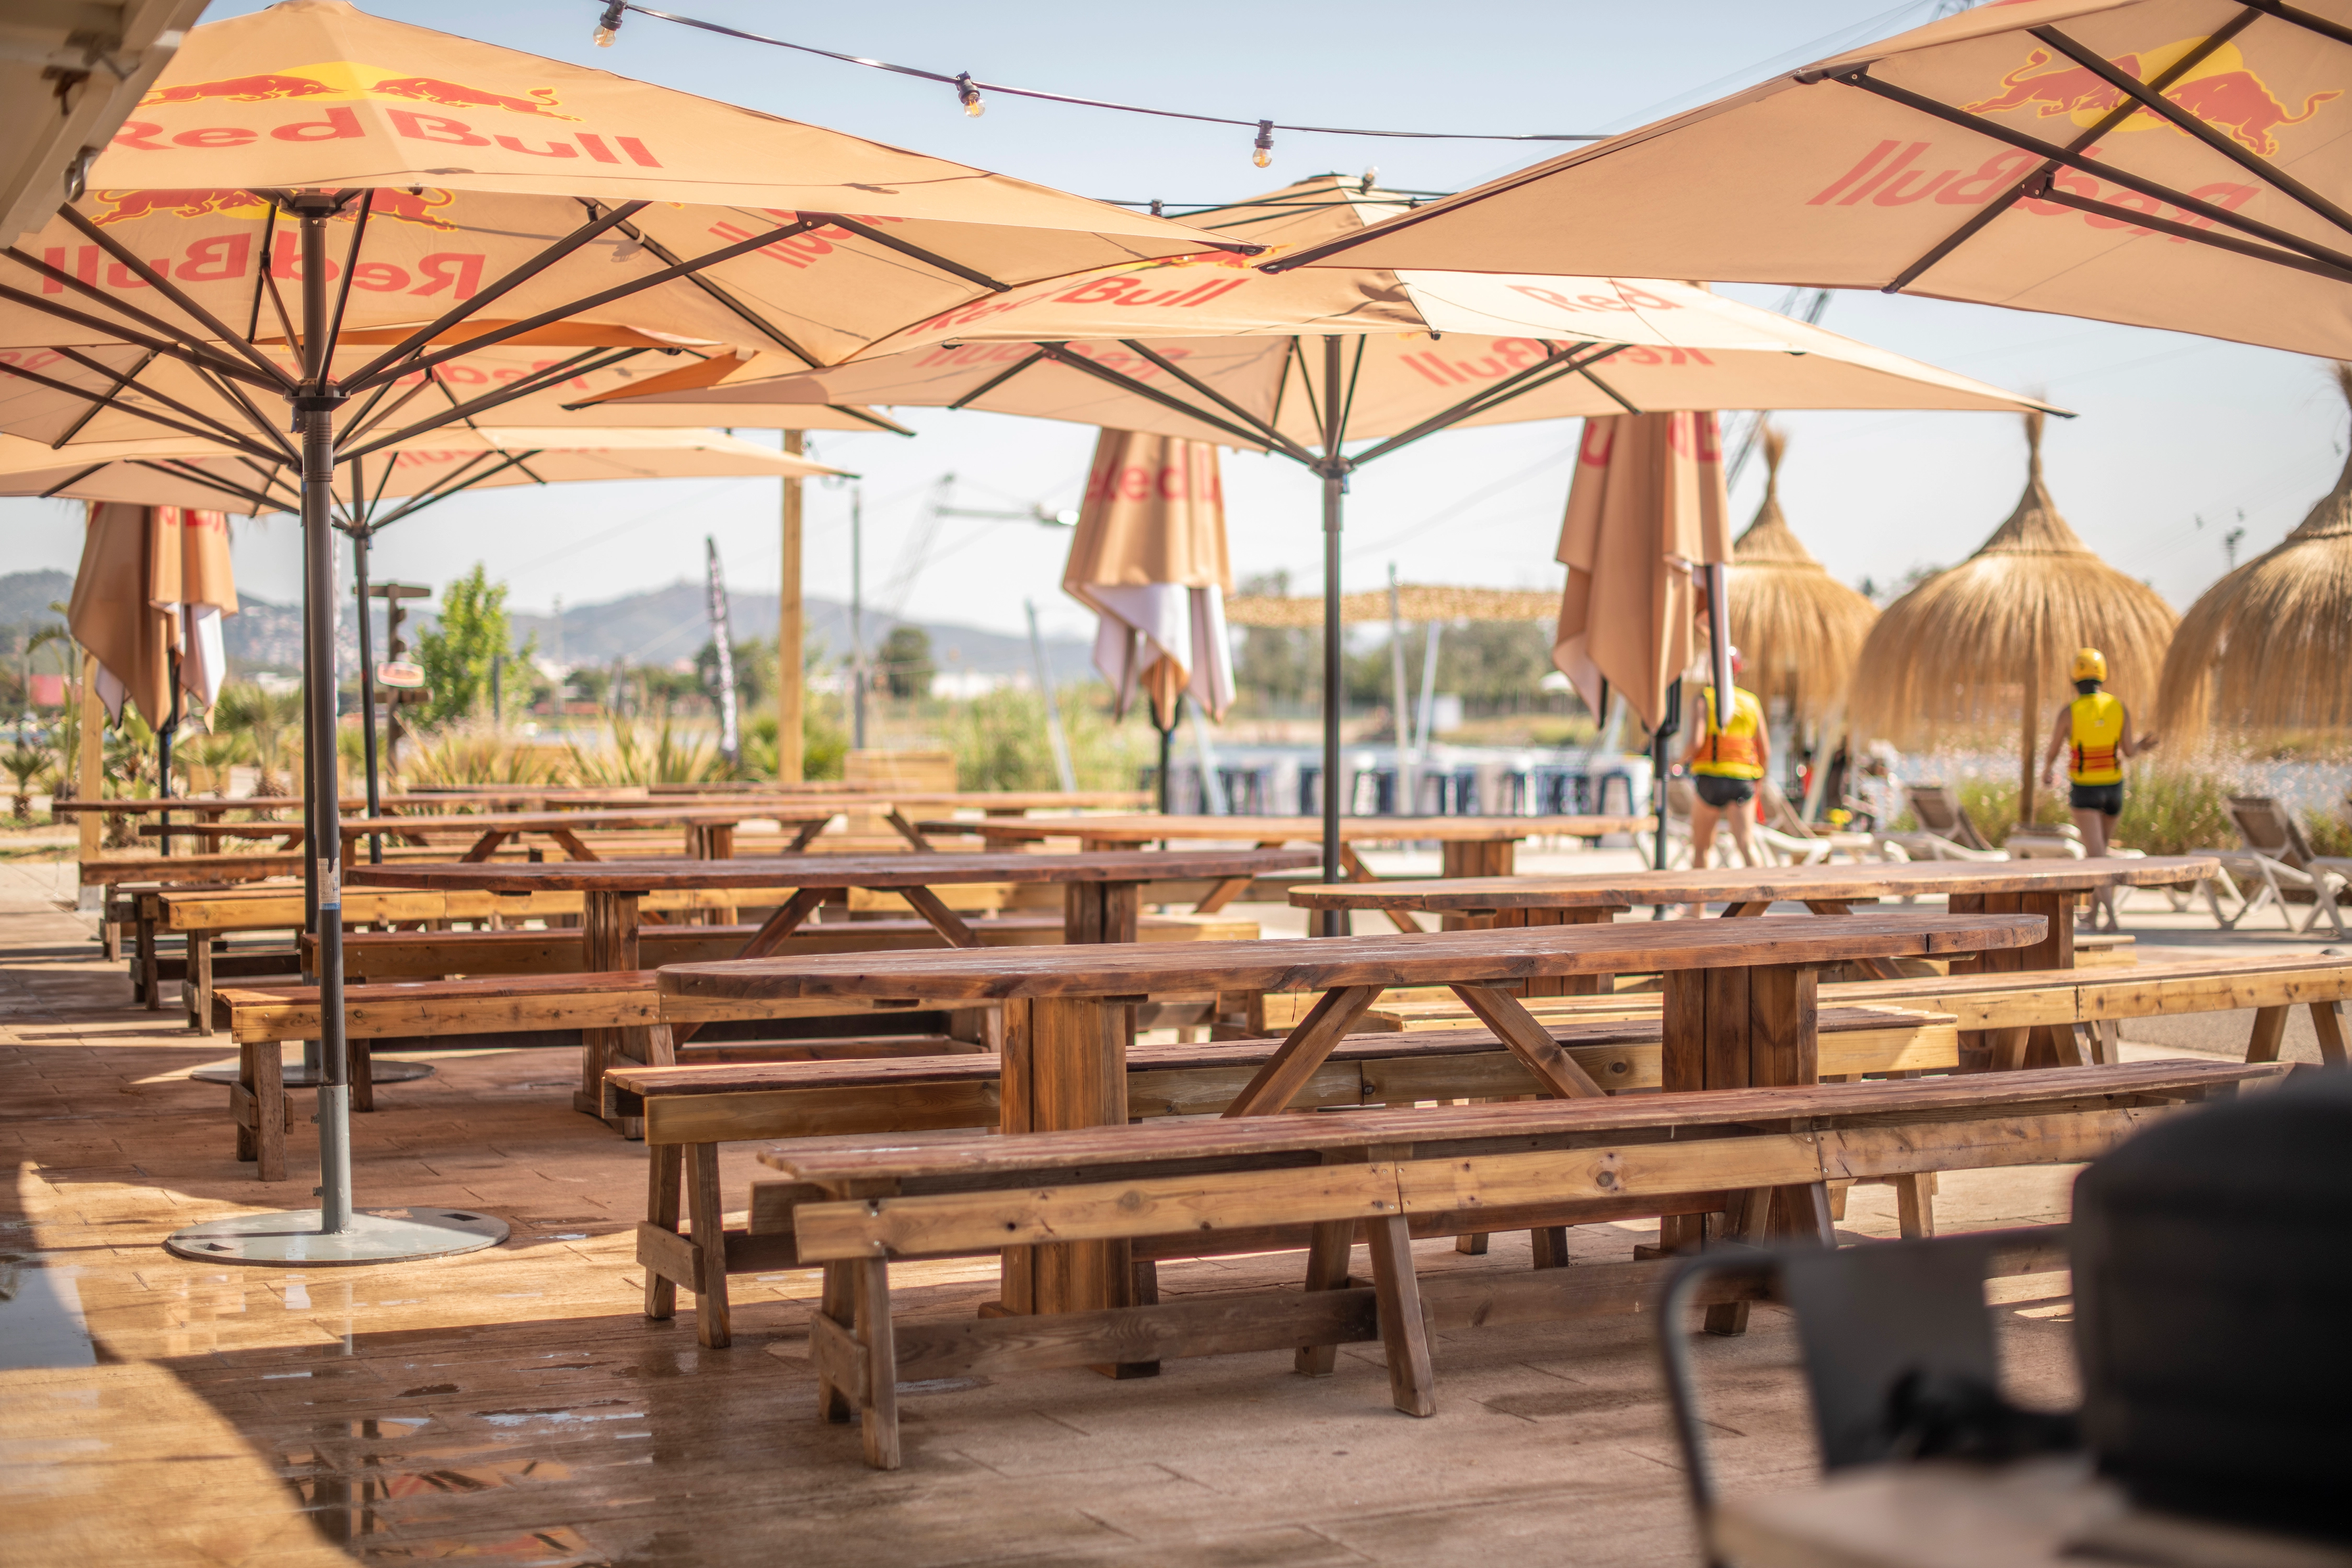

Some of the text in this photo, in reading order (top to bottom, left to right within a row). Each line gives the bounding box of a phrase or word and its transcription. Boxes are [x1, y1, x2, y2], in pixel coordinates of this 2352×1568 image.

[103, 107, 664, 168] Red Bull
[1051, 277, 1250, 307] Bull
[1505, 280, 1684, 313] Red
